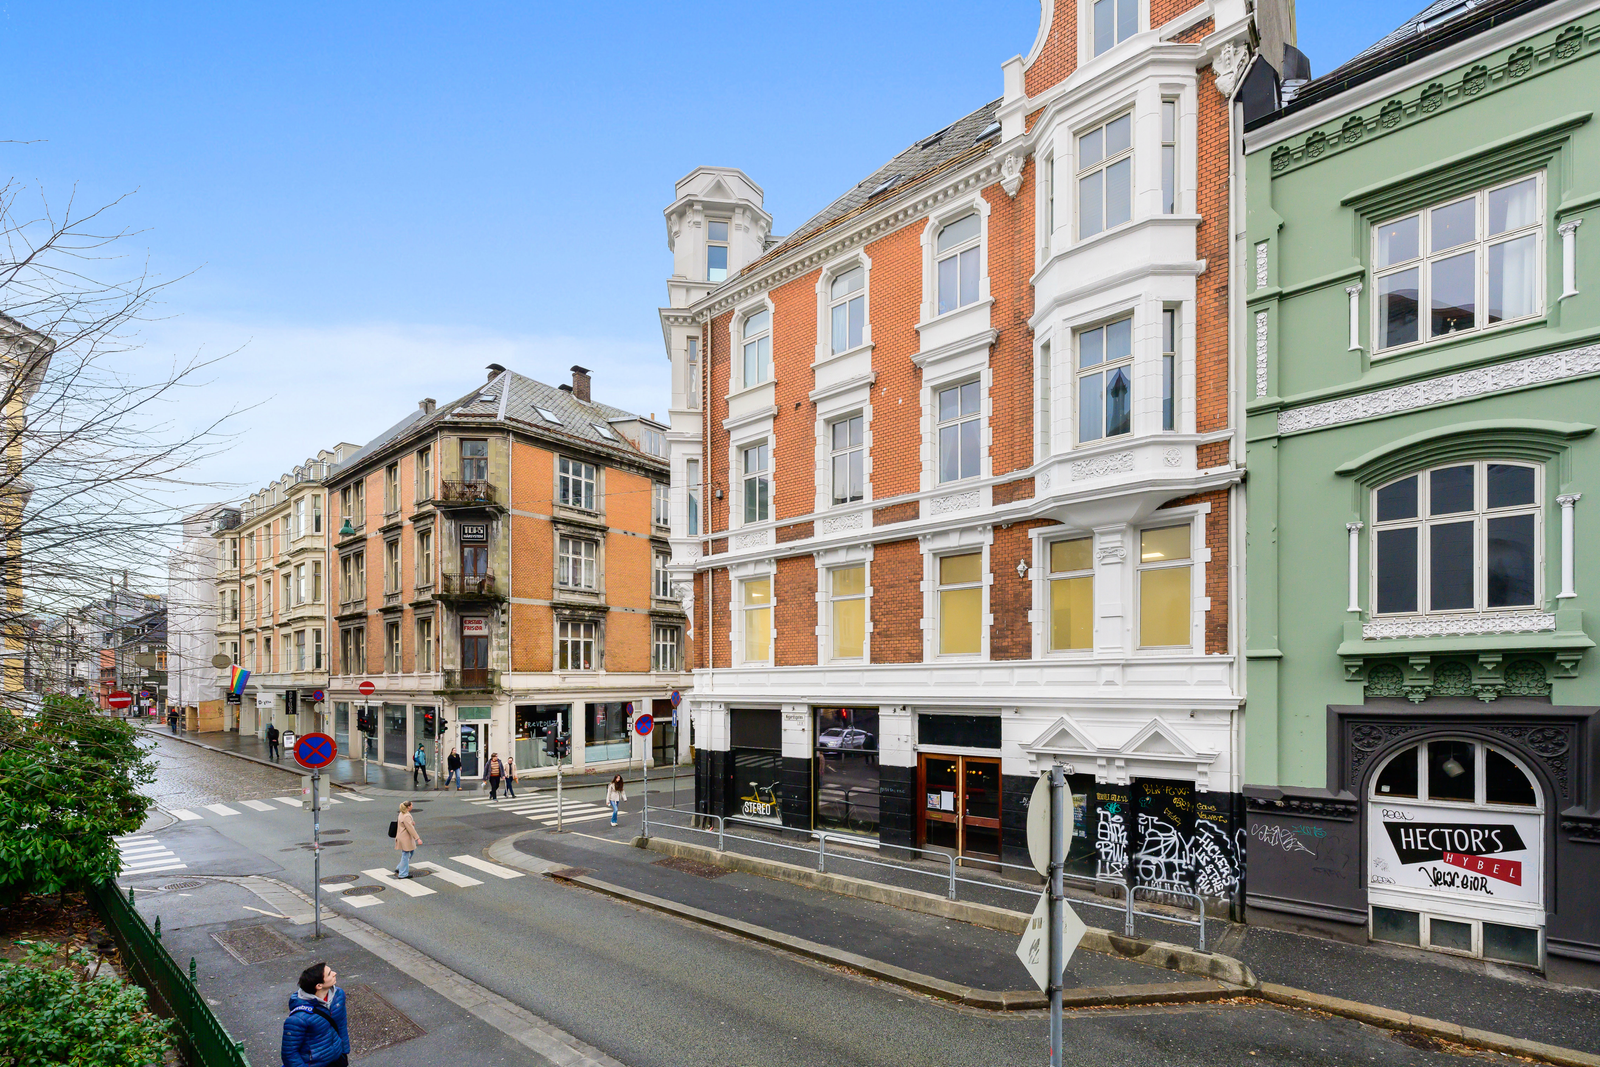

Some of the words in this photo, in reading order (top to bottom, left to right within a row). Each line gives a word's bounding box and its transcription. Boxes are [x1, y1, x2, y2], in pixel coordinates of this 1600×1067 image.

[744, 801, 771, 816] STEREO
[1399, 828, 1504, 853] HECTOR'S
[1446, 853, 1516, 879] HYBEL
